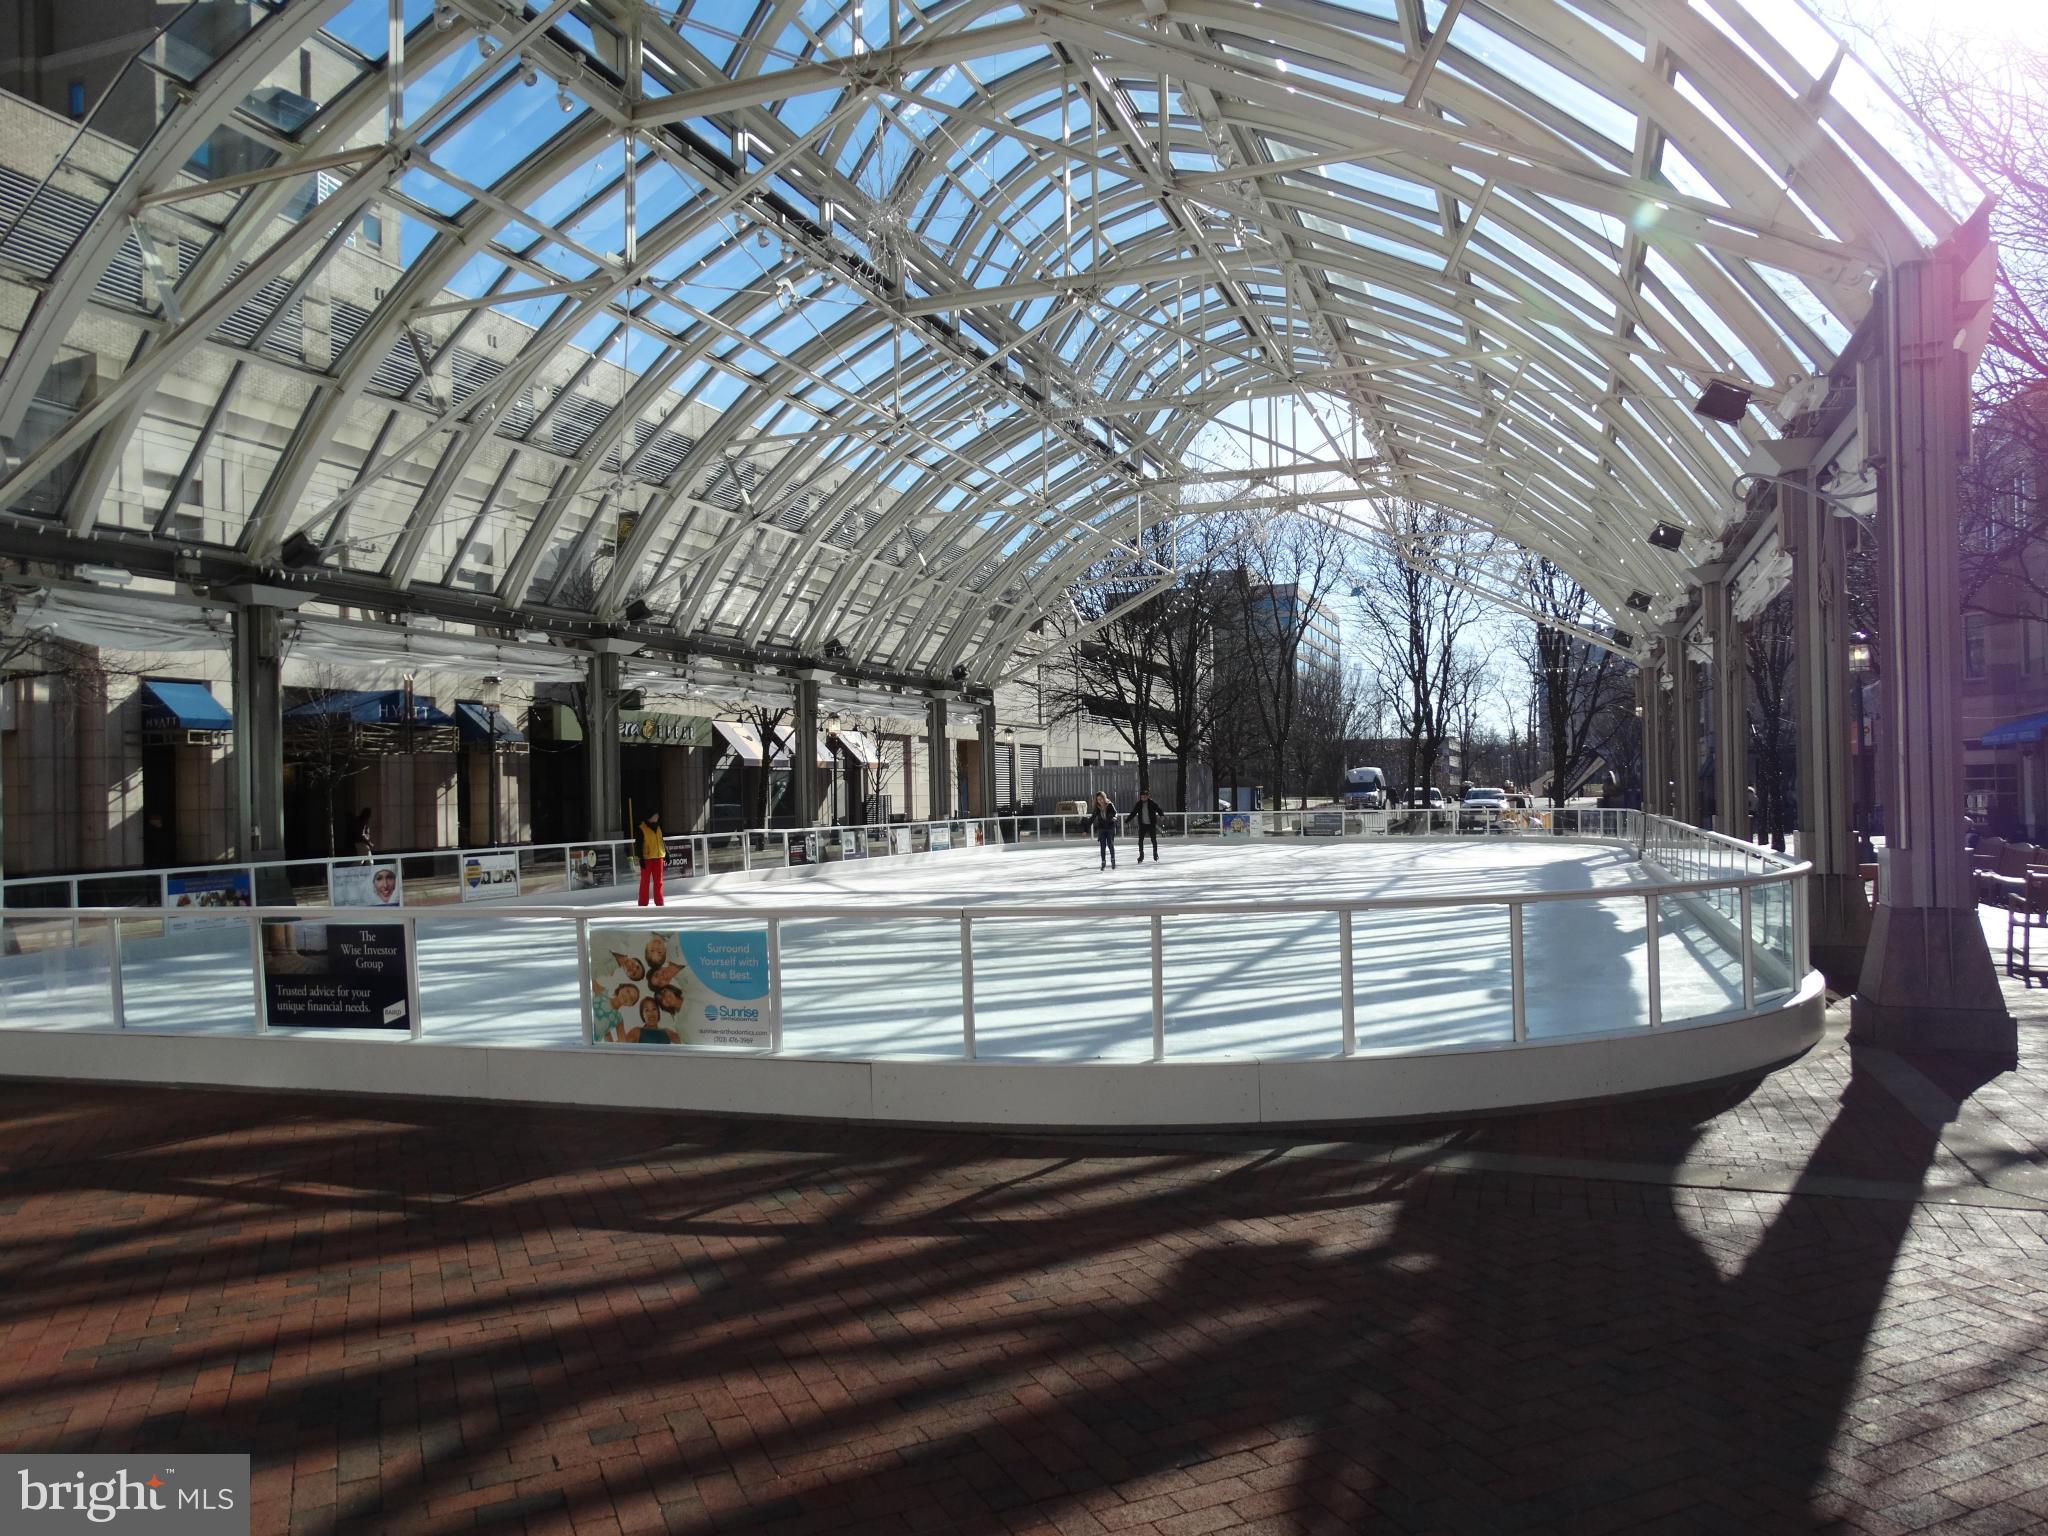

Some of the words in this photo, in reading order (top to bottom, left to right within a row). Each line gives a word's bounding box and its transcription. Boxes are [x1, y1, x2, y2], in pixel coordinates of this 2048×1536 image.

[378, 703, 429, 720] HYTT
[360, 930, 376, 942] The
[341, 944, 362, 956] Wise
[364, 944, 397, 956] Investor
[707, 943, 750, 954] Surround
[355, 957, 384, 972] Group
[699, 956, 736, 967] Yourself
[738, 957, 759, 967] with
[712, 969, 727, 980] the
[729, 970, 752, 981] Best.
[276, 984, 307, 997] Trusted
[309, 985, 335, 997] advice
[337, 985, 349, 997] for
[351, 989, 371, 999] your
[277, 1001, 305, 1013] unique
[307, 999, 343, 1012] financial
[345, 1001, 371, 1012] needs.
[719, 1005, 759, 1018] Sunrise
